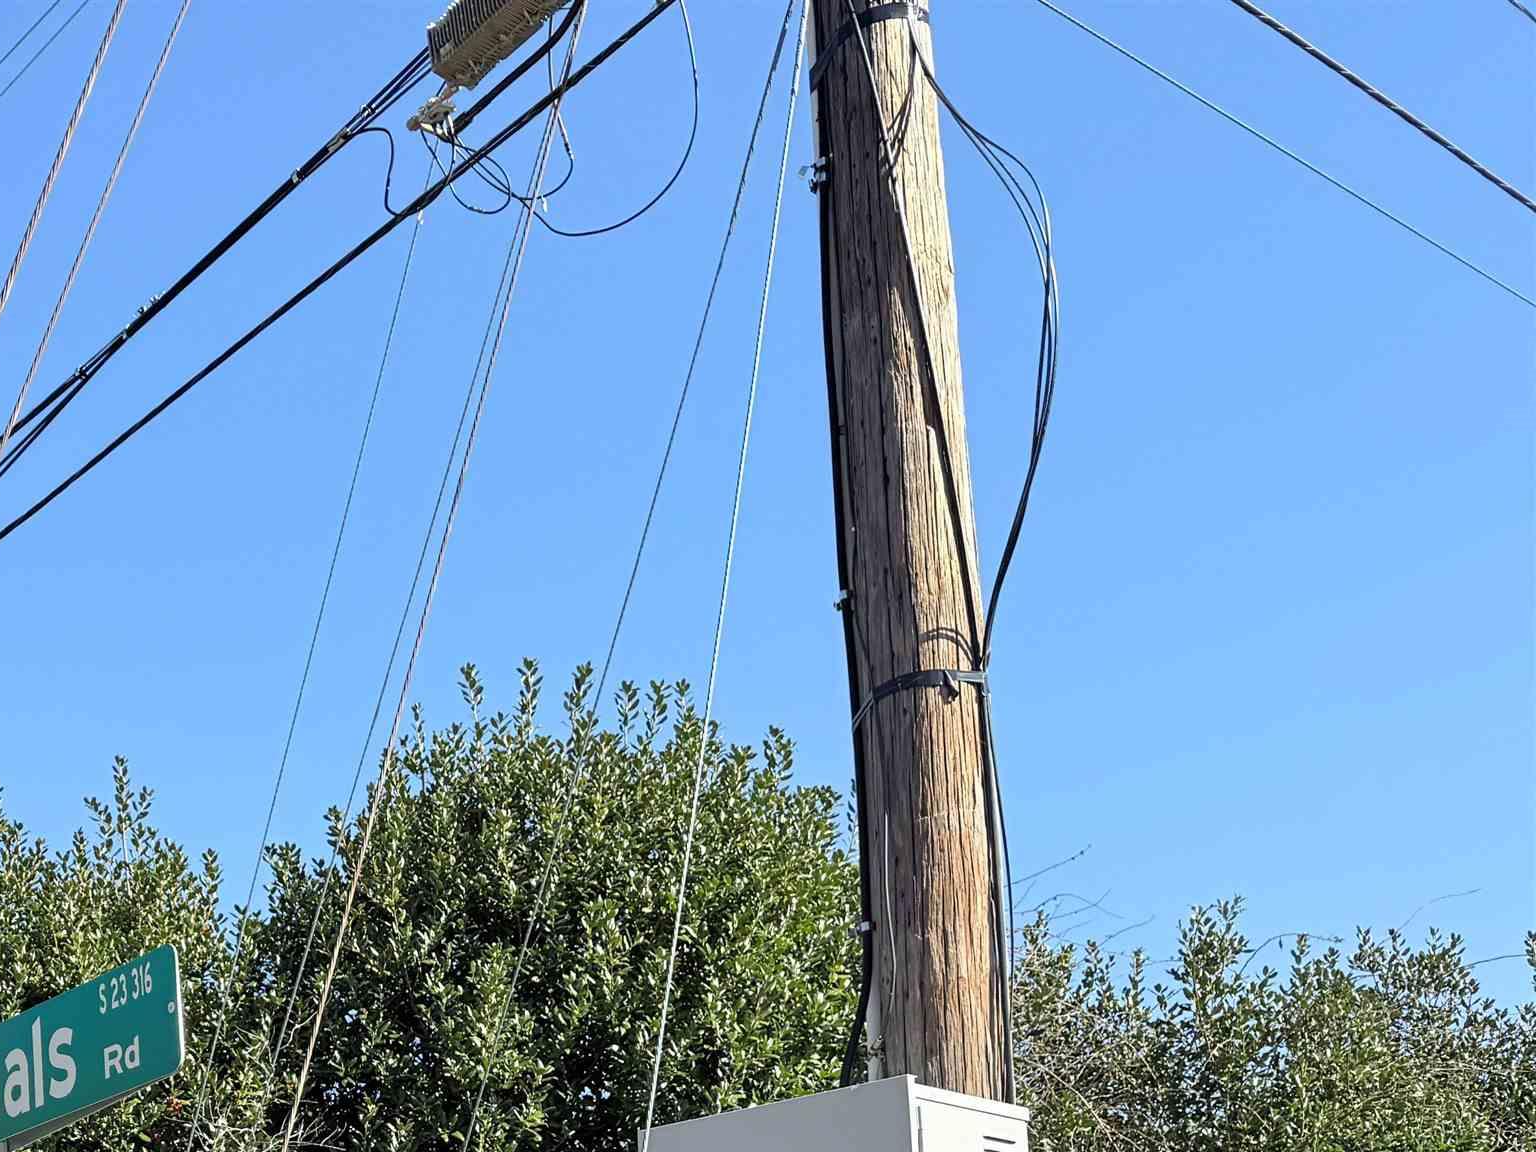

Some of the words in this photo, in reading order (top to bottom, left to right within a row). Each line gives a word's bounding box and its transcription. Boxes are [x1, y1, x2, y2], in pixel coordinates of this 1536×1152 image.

[98, 983, 107, 1015] S
[110, 973, 128, 1010] 23
[131, 961, 153, 1000] 316
[104, 1035, 140, 1080] Rd
